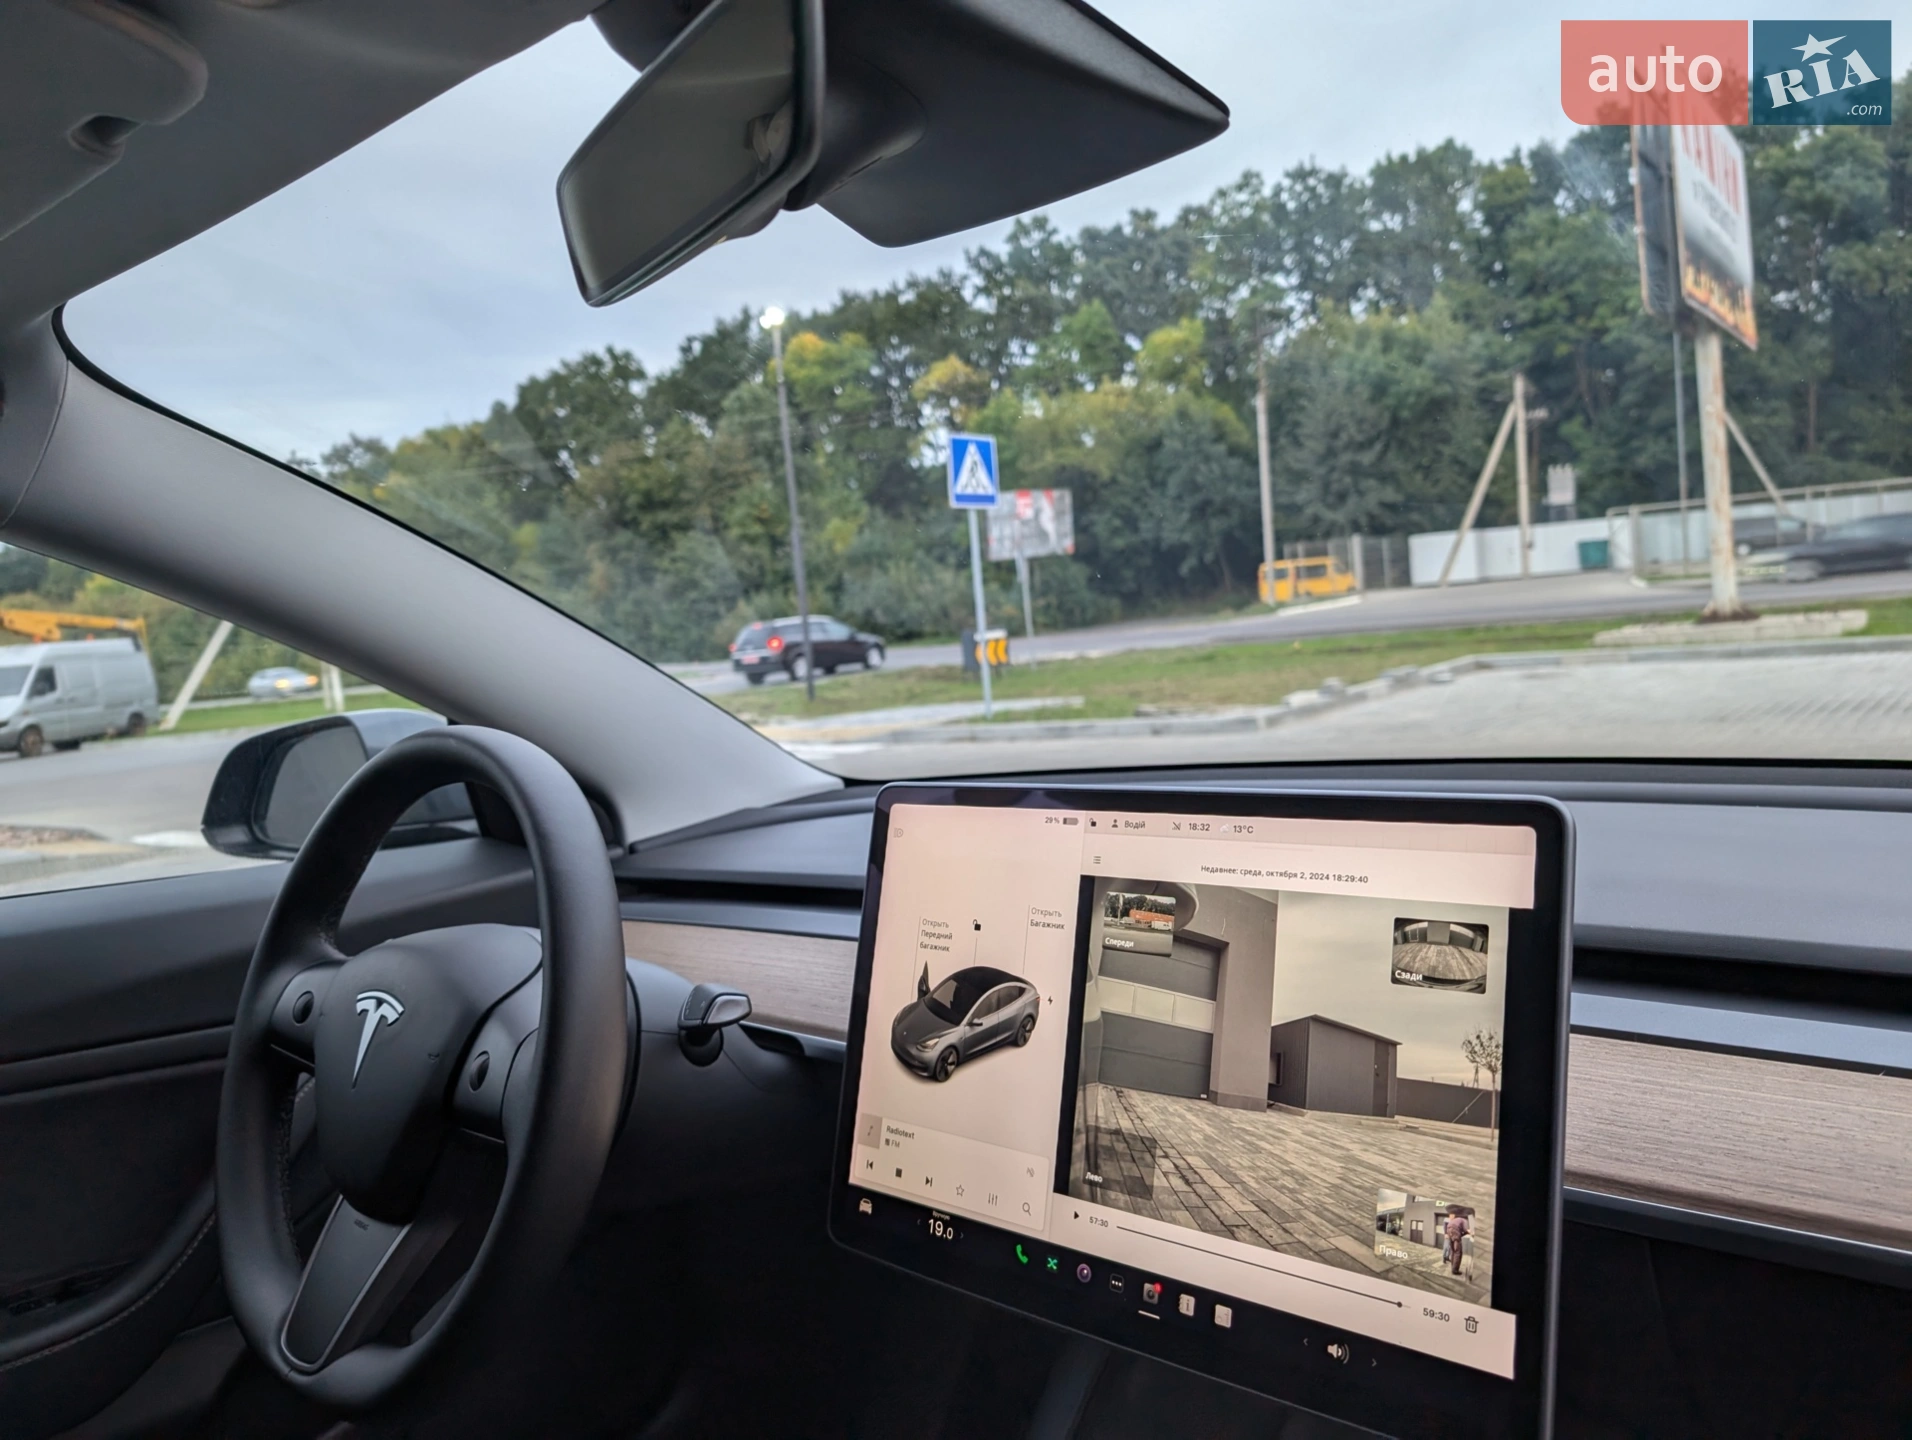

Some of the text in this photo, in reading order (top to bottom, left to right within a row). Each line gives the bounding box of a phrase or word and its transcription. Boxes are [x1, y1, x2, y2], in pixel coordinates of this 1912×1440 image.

[1124, 820, 1146, 830] Водій
[1188, 822, 1211, 832] 18:32
[1233, 824, 1254, 834] 13°C
[1200, 865, 1369, 884] Недавнее: среда, октября 2, 2024 18:29:40
[1031, 907, 1062, 918] Открыть
[922, 918, 950, 928] Открыть
[1030, 918, 1066, 930] Багажник
[920, 929, 953, 940] Передний
[920, 941, 950, 952] багажник
[1104, 937, 1135, 949] Спереди
[1394, 969, 1423, 981] Сзади
[886, 1125, 915, 1140] Radiotext
[1089, 1216, 1109, 1228] 57:30
[928, 1217, 954, 1240] 19.0
[1379, 1244, 1408, 1259] Право
[1423, 1307, 1450, 1322] 59:30
